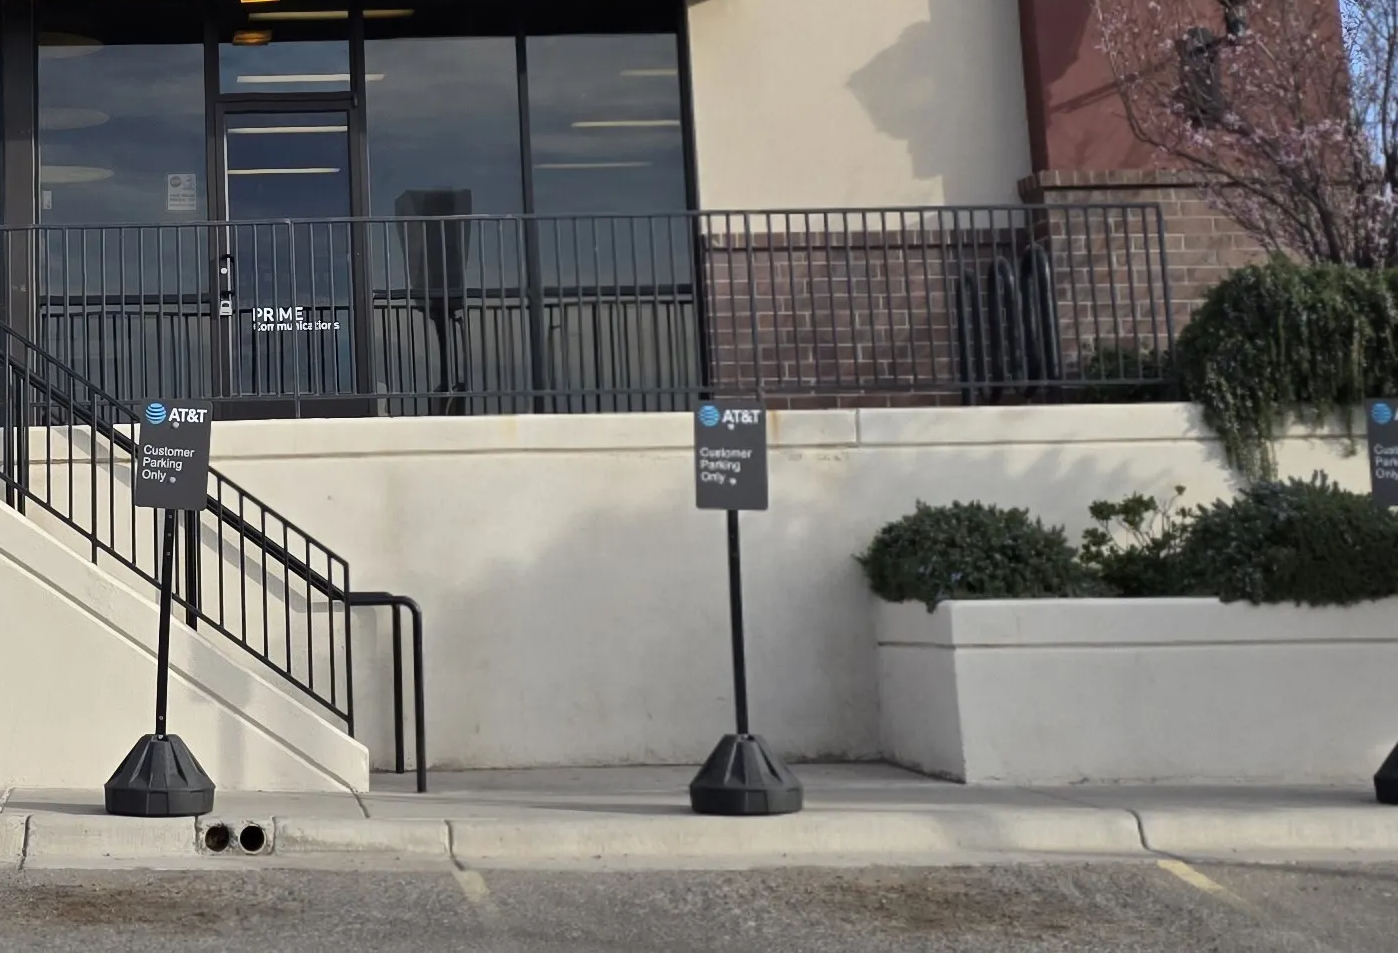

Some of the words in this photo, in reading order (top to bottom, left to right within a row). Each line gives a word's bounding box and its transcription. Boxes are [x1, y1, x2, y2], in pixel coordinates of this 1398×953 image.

[168, 408, 208, 423] AT&T
[722, 409, 762, 424] AT&T
[143, 444, 195, 458] Customer
[699, 447, 753, 459] Customer
[142, 457, 183, 472] Parking
[700, 459, 742, 473] Parking
[142, 469, 167, 483] Only
[701, 471, 726, 485] Only
